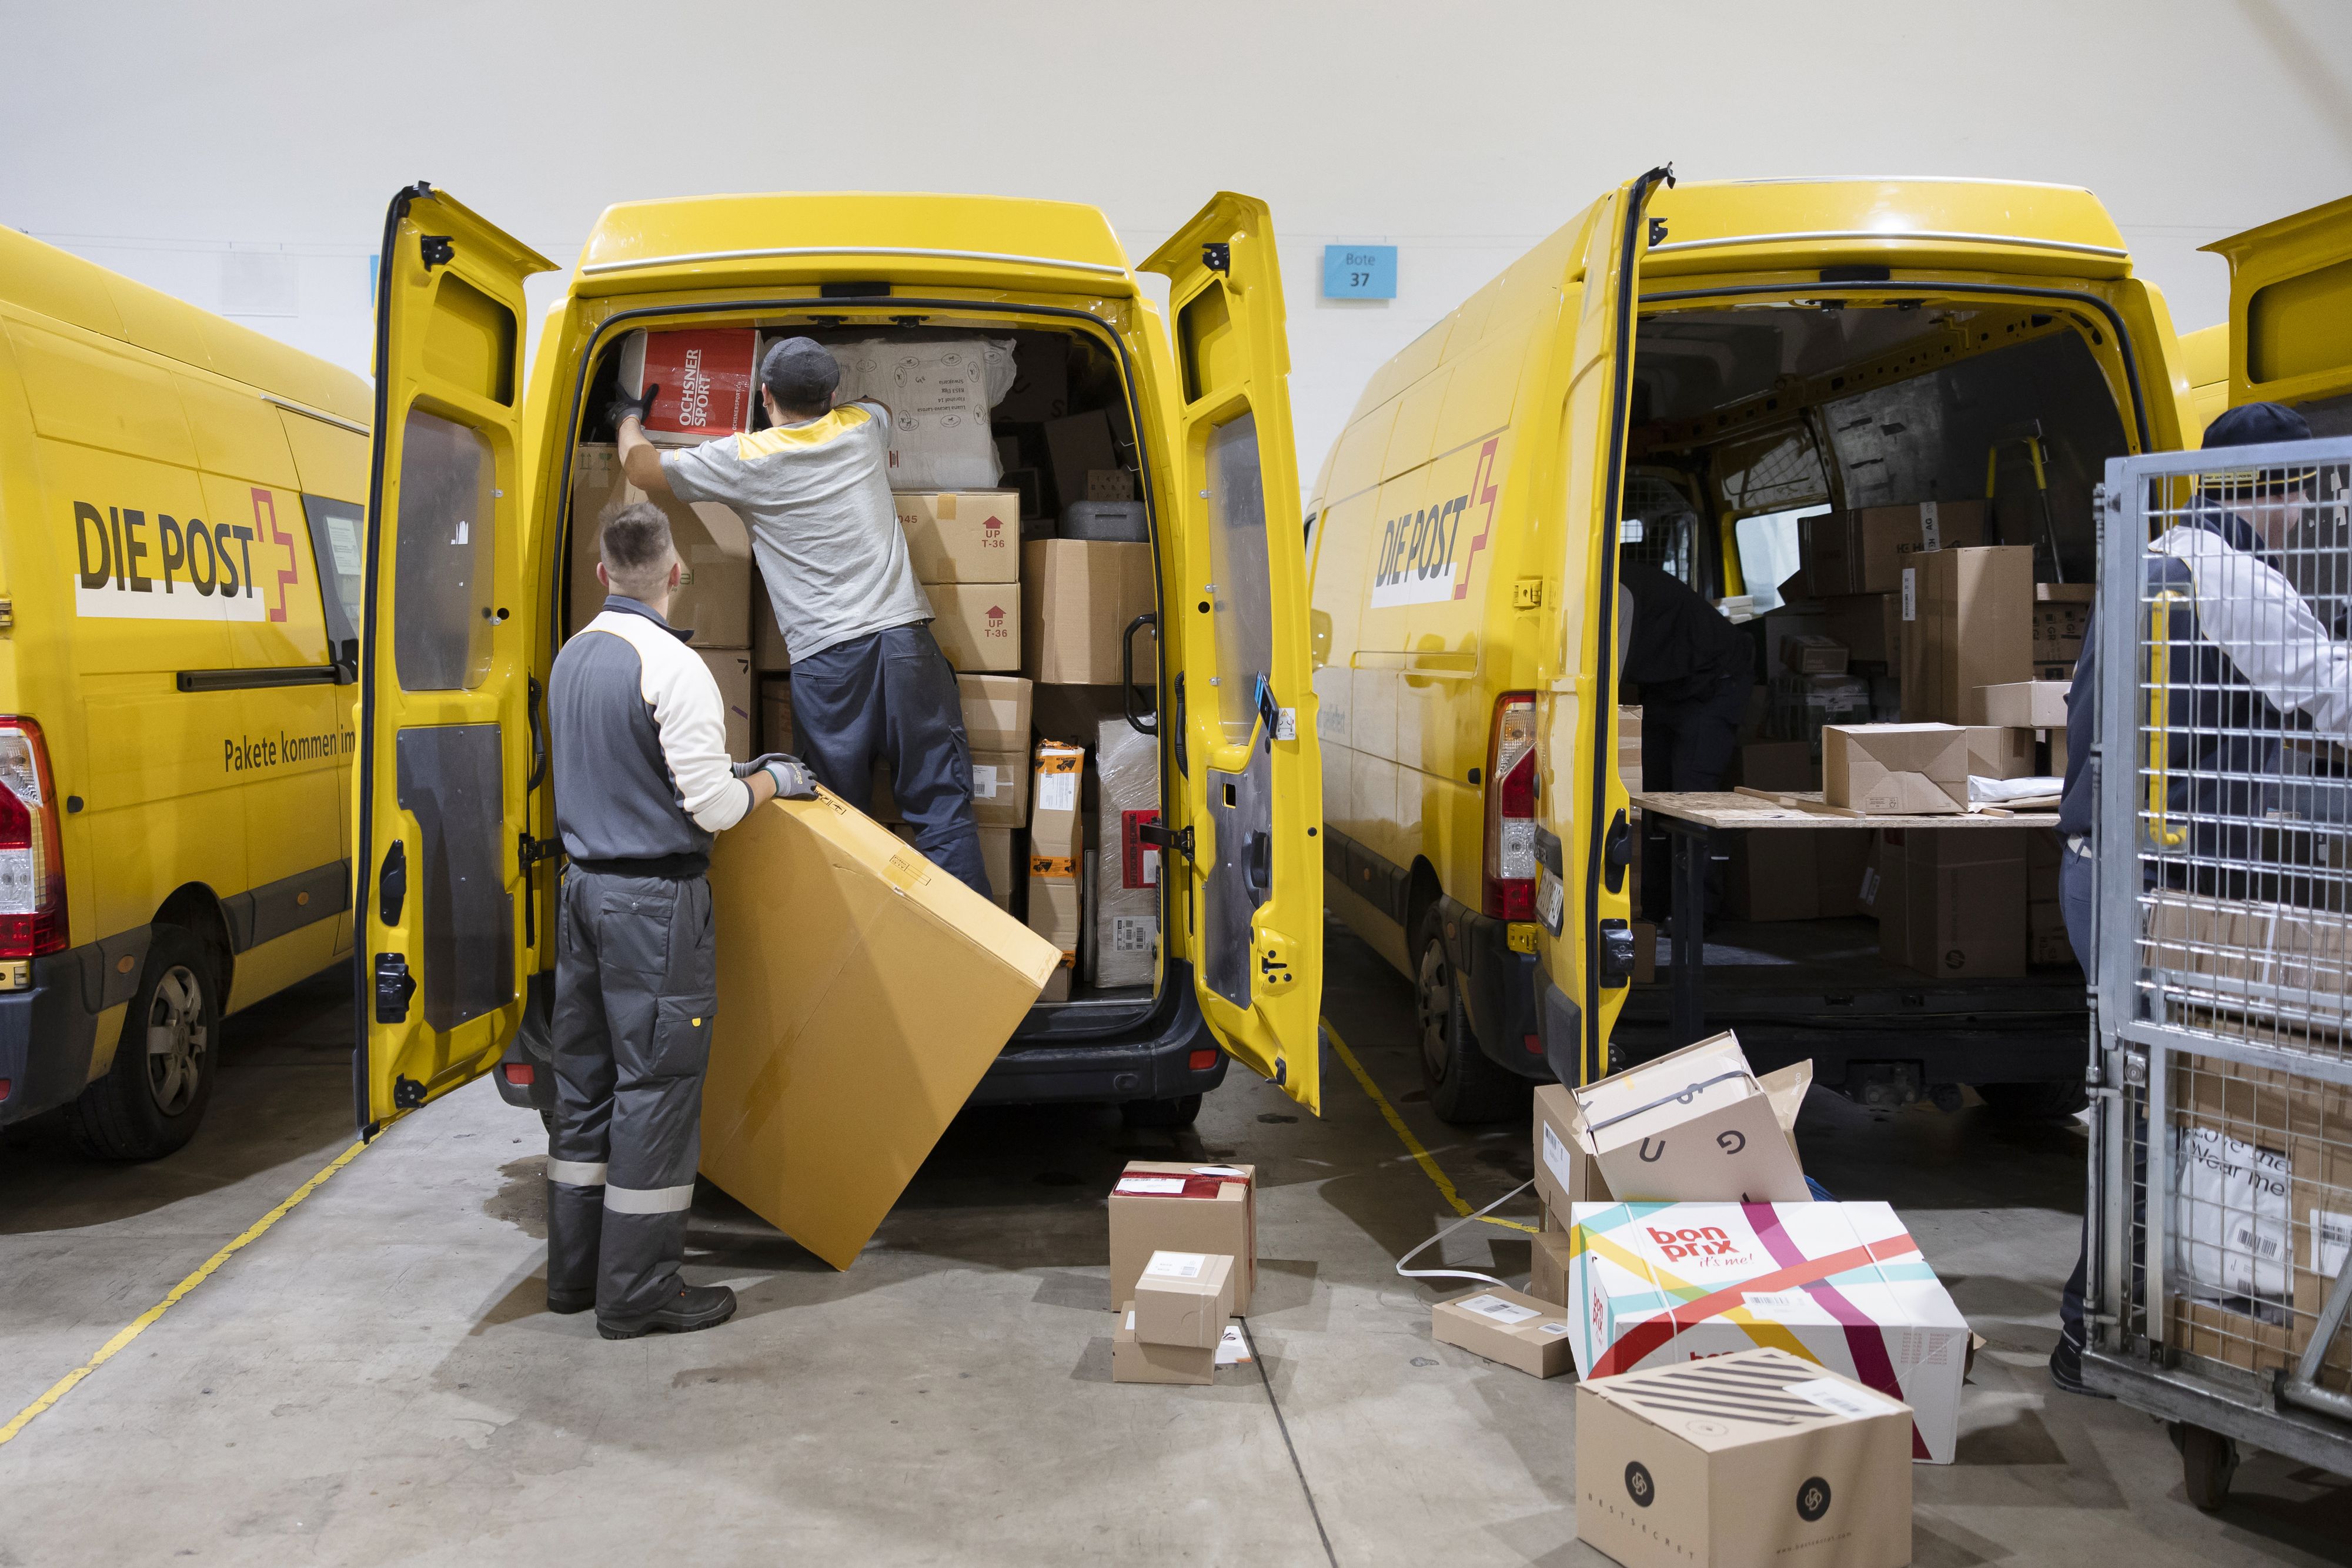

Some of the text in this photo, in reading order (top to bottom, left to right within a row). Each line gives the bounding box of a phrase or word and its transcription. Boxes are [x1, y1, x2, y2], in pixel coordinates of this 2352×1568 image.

[1346, 253, 1375, 266] Bote
[1350, 272, 1370, 287] 37
[679, 349, 699, 426] OCHSNER
[694, 374, 710, 427] SPORT
[74, 501, 152, 593] DIE
[158, 513, 254, 599] POST
[981, 540, 1005, 548] T-36
[1376, 494, 1468, 587] DIE POST
[988, 619, 1003, 627] UP
[225, 735, 276, 772] Pakete
[281, 731, 337, 764] kommen
[1639, 1137, 1666, 1162] U
[1716, 1130, 1746, 1155] G
[2192, 1139, 2285, 1196] Wear me
[1646, 1226, 1729, 1245] bon
[1660, 1241, 1740, 1262] prix
[1699, 1253, 1755, 1268] it's me!
[1593, 1286, 1603, 1320] bon
[1593, 1306, 1602, 1335] prix
[1589, 1493, 1694, 1559] BESTSECRET
